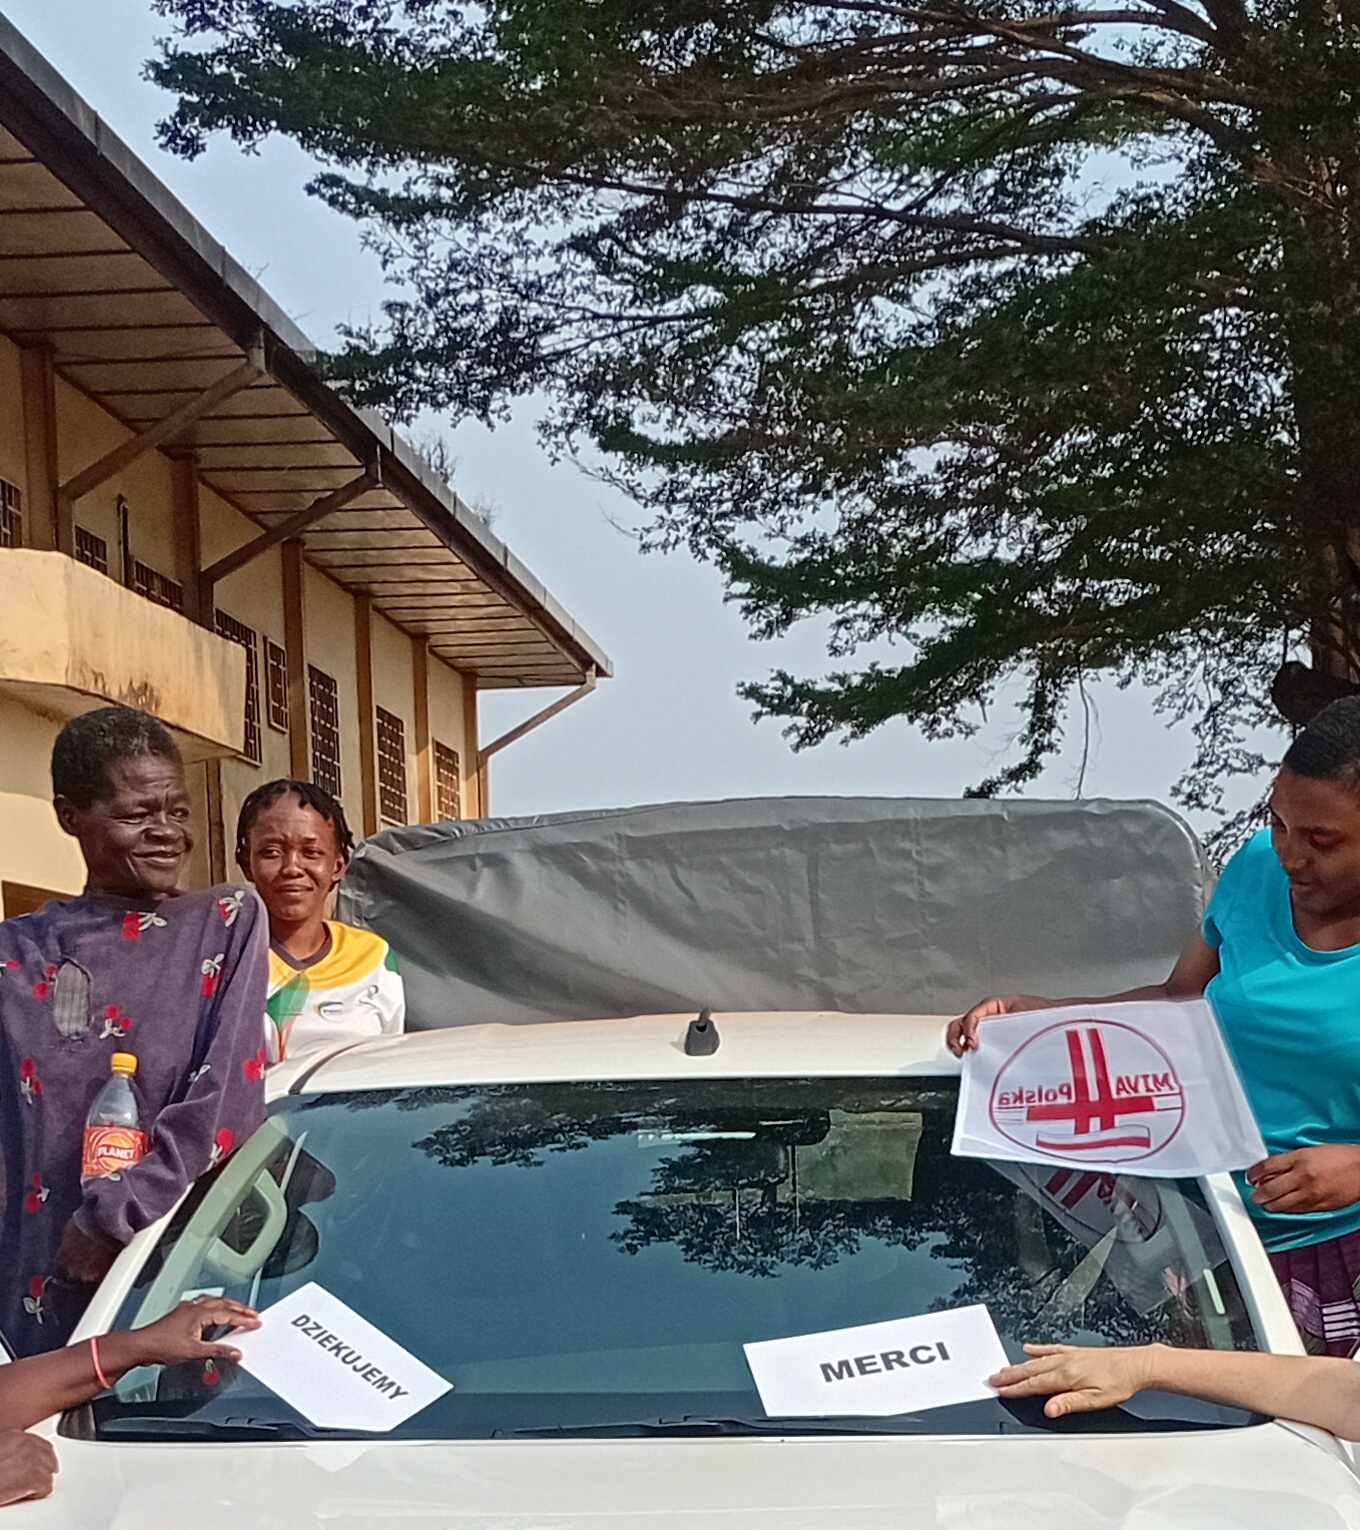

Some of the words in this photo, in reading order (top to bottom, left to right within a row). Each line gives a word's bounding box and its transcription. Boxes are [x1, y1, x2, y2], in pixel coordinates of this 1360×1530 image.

[98, 1147, 135, 1160] PLANET
[290, 1313, 409, 1400] DZIEKUJEMY
[819, 1341, 951, 1383] MERCI
